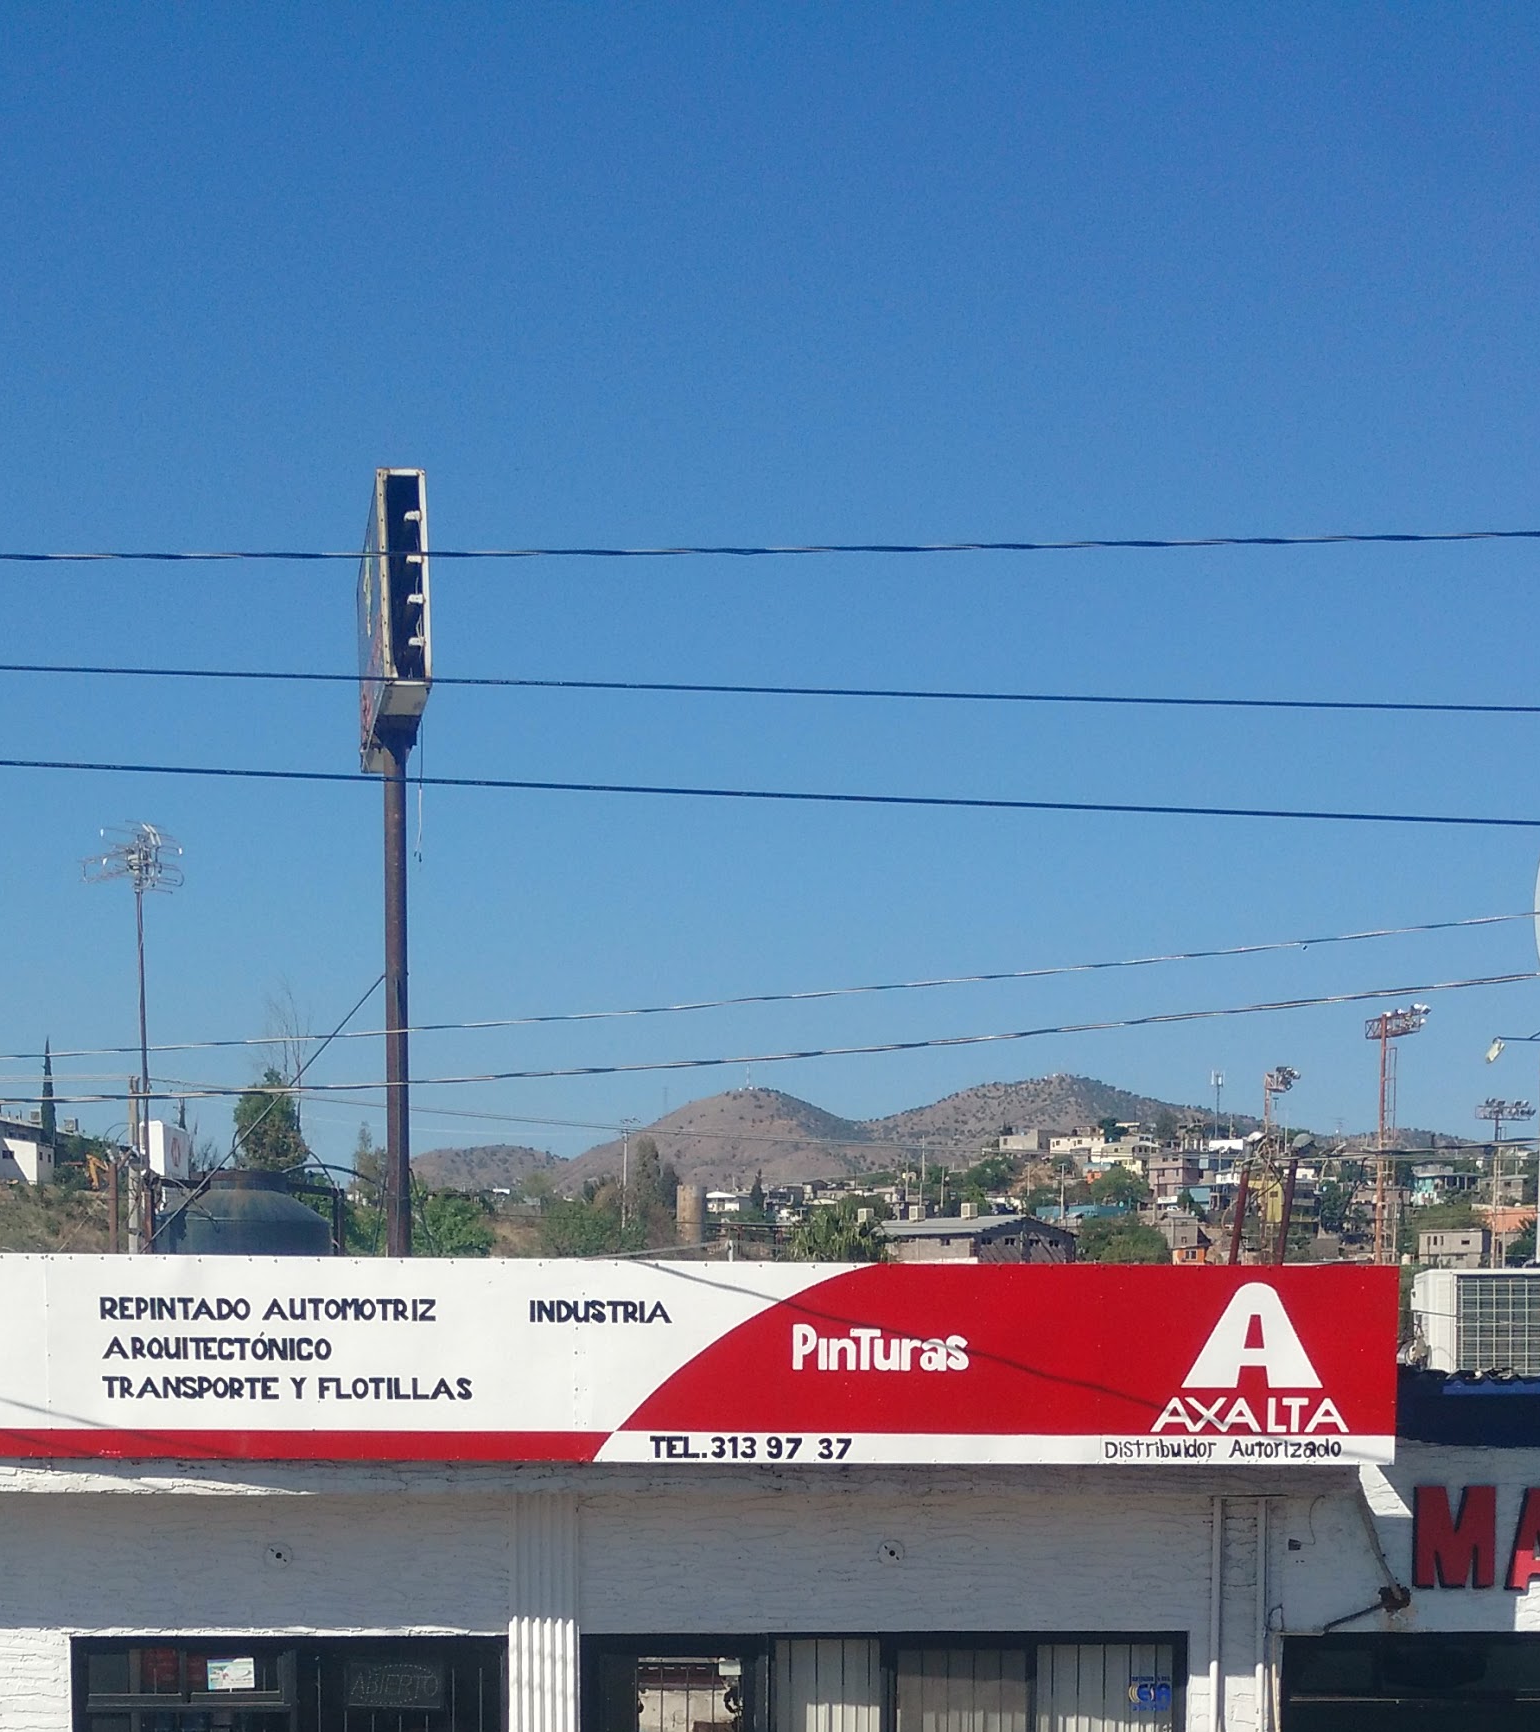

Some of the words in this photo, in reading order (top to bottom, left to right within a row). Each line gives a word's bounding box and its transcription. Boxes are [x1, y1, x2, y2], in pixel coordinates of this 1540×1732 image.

[99, 1296, 251, 1321] REPINTADO
[261, 1297, 437, 1322] AUTOMOTRIZ
[529, 1299, 673, 1324] INDUSTRIA
[102, 1331, 332, 1361] ARQUITECTÓNICO
[101, 1375, 280, 1400] TRANSPORTE
[289, 1376, 308, 1400] Y
[317, 1377, 473, 1401] FLOTILLAS
[1150, 1396, 1350, 1434] AXALTA
[766, 1436, 803, 1460] 97
[817, 1437, 853, 1460] 37
[1104, 1438, 1217, 1459] Distribuidor
[1228, 1437, 1342, 1459] Autorizado
